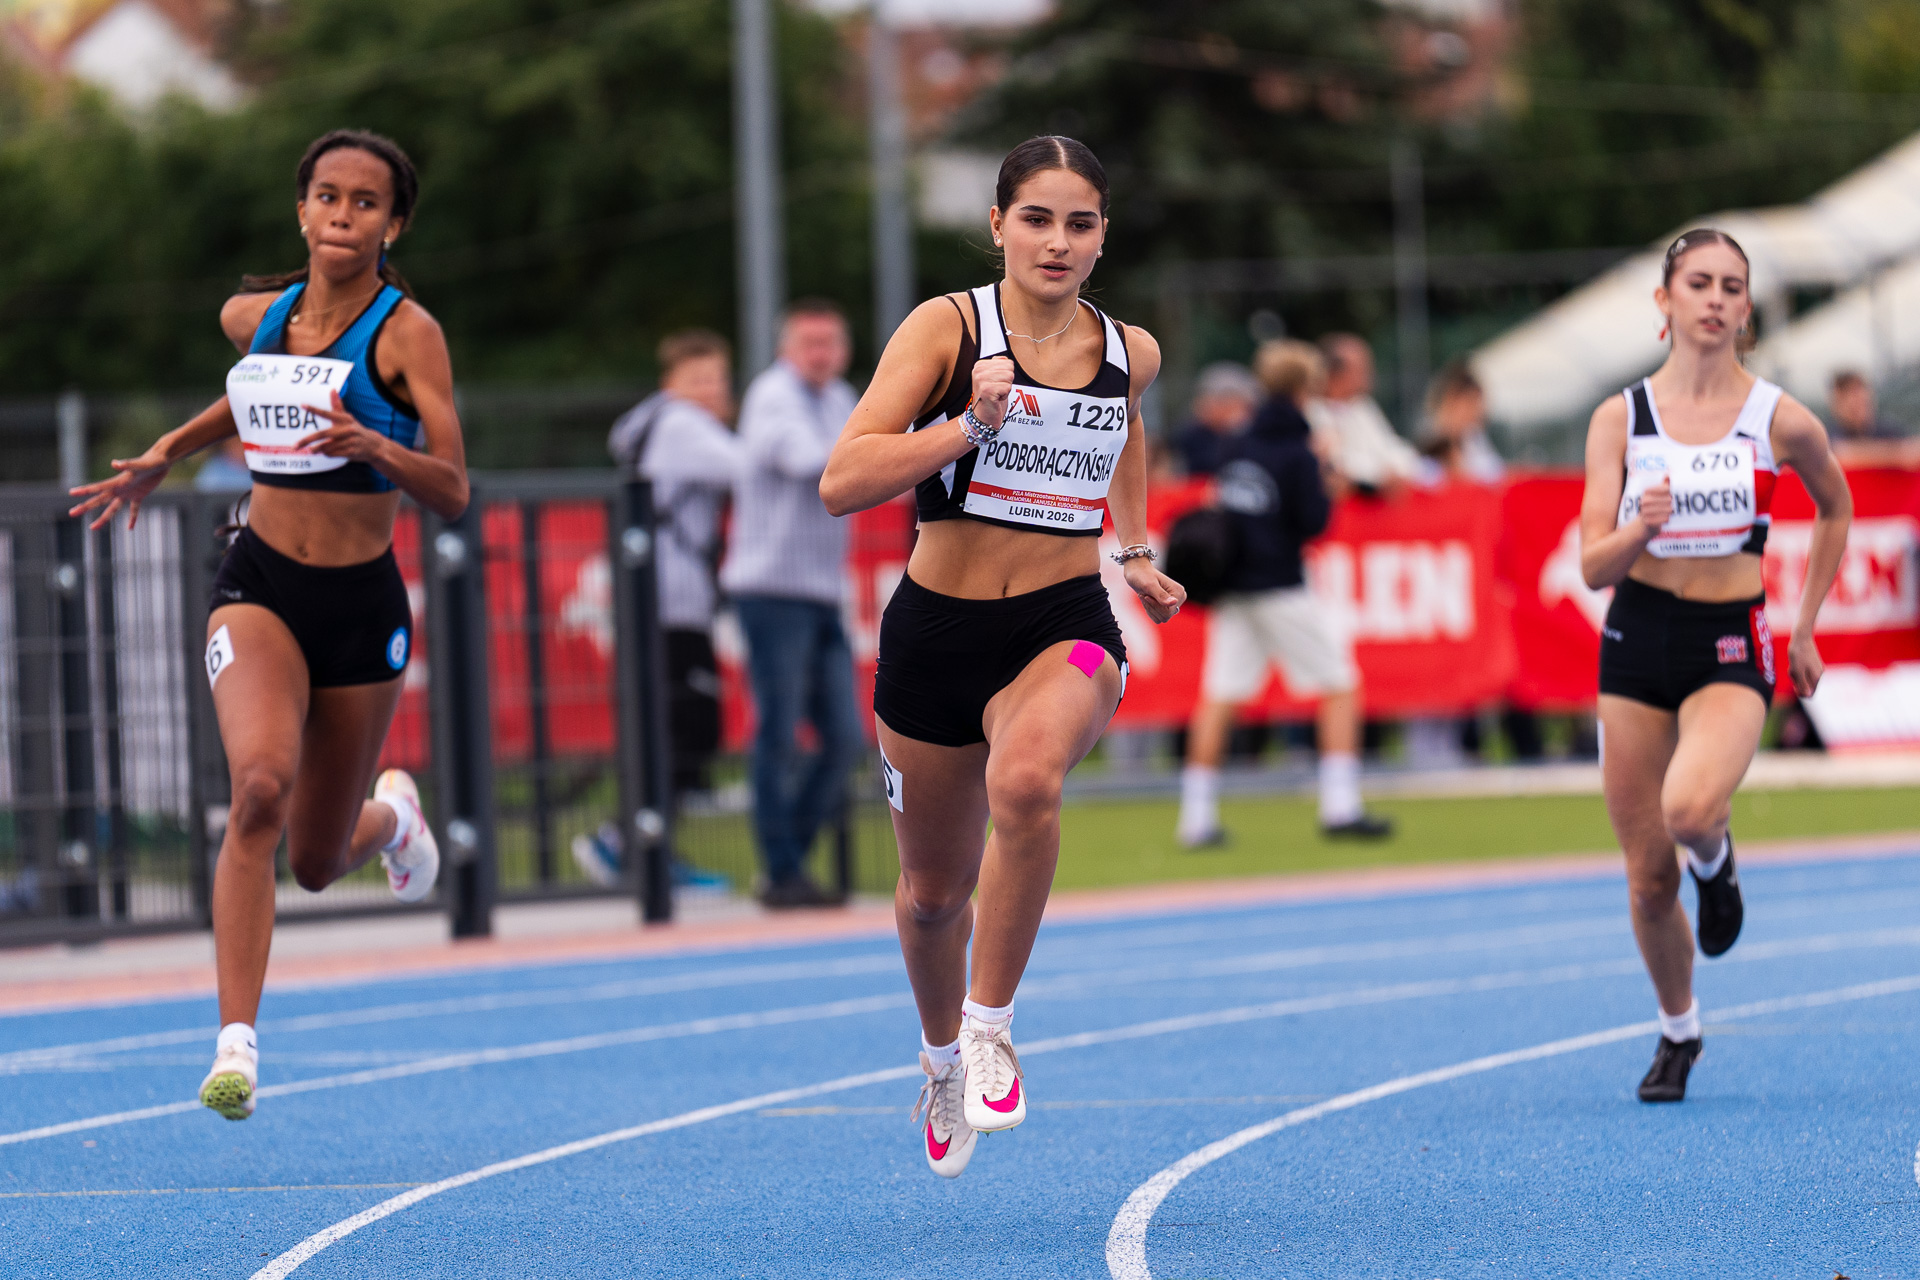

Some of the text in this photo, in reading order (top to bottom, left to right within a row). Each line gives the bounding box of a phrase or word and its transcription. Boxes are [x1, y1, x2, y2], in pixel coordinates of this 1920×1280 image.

[290, 364, 334, 385] 591
[249, 404, 319, 430] ATEBA
[1018, 417, 1030, 425] BEZ
[1030, 419, 1044, 427] WAD
[1066, 402, 1125, 432] 1229
[983, 440, 1115, 482] PODBORĄCZYŃSKA
[1692, 451, 1739, 473] 670
[1008, 505, 1075, 523] LUBIN 2026
[208, 640, 222, 675] 6
[883, 756, 894, 798] 5
